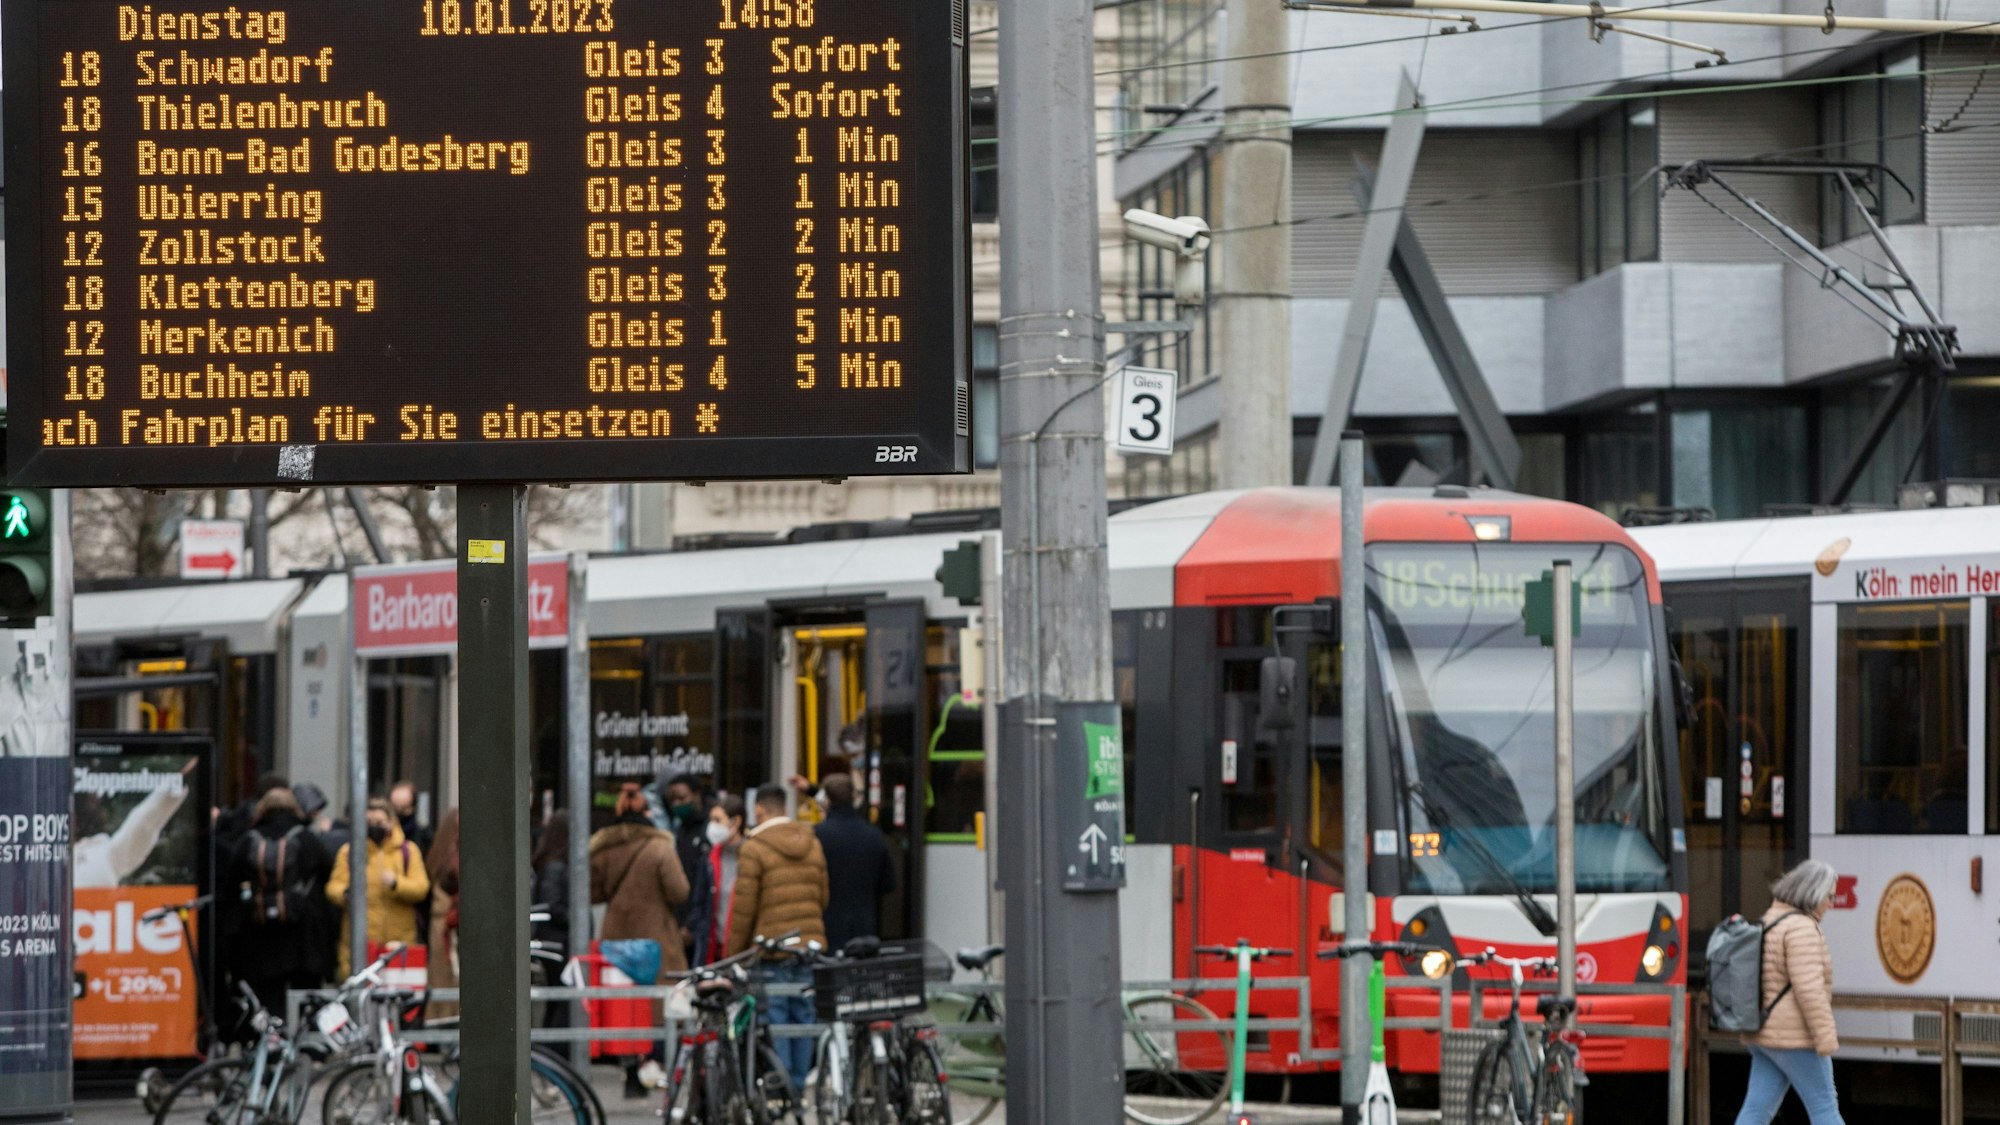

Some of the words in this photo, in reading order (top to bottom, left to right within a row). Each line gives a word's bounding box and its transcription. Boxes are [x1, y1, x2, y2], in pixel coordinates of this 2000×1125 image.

[119, 5, 286, 43] Dienstag
[420, 0, 614, 35] 10.01.2023
[719, 0, 814, 29] 14:58
[60, 51, 101, 87] 18
[136, 47, 333, 86] Schwadorf
[585, 36, 681, 77] Gleis
[705, 38, 724, 75] 3
[771, 35, 901, 74] Sofort
[61, 96, 102, 132] 18
[137, 91, 386, 131] Thielenbruch
[585, 85, 681, 123] Gleis
[706, 84, 725, 120] 4
[772, 81, 901, 119] Sofort
[62, 141, 102, 177] 16
[138, 137, 310, 176] Bonn-Bad
[335, 134, 529, 175] Godesberg
[586, 130, 682, 168] Gleis
[706, 129, 725, 166] 3
[795, 127, 813, 164] 1
[838, 126, 899, 163] Min
[62, 186, 103, 222] 15
[138, 183, 322, 224] Ubierring
[587, 175, 682, 212] Gleis
[707, 174, 726, 211] 3
[795, 172, 814, 209] 1
[839, 171, 899, 209] Min
[63, 231, 103, 266] 12
[139, 229, 325, 265] Zollstock
[587, 221, 683, 258] Gleis
[708, 219, 726, 256] 2
[795, 218, 814, 254] 2
[840, 216, 899, 253] Min
[63, 275, 104, 311] 18
[140, 272, 375, 312] Klettenberg
[588, 266, 683, 303] Gleis
[708, 265, 727, 301] 3
[796, 263, 815, 299] 2
[840, 262, 900, 299] Min
[64, 320, 104, 356] 12
[140, 316, 334, 355] Merkenich
[588, 311, 684, 348] Gleis
[709, 310, 727, 346] 1
[796, 308, 815, 343] 5
[840, 307, 901, 343] Min
[64, 365, 105, 401] 18
[140, 362, 310, 400] Buchheim
[589, 356, 684, 393] Gleis
[709, 355, 728, 390] 4
[796, 353, 816, 388] 5
[840, 352, 901, 388] Min
[1133, 375, 1163, 389] Gleis
[122, 407, 288, 447] Fahrplan
[313, 405, 375, 441] für
[400, 404, 457, 440] Sie
[482, 402, 670, 439] einsetzen
[1129, 393, 1161, 441] 3
[875, 445, 919, 462] BBR
[1383, 559, 1417, 609] 18
[1910, 564, 1958, 595] mein
[596, 710, 640, 738] Grüner
[641, 709, 689, 736] kommt
[32, 812, 70, 843] BOYS
[24, 844, 53, 863] HITS
[31, 910, 61, 933] KÖLN
[14, 937, 57, 957] ARENA
